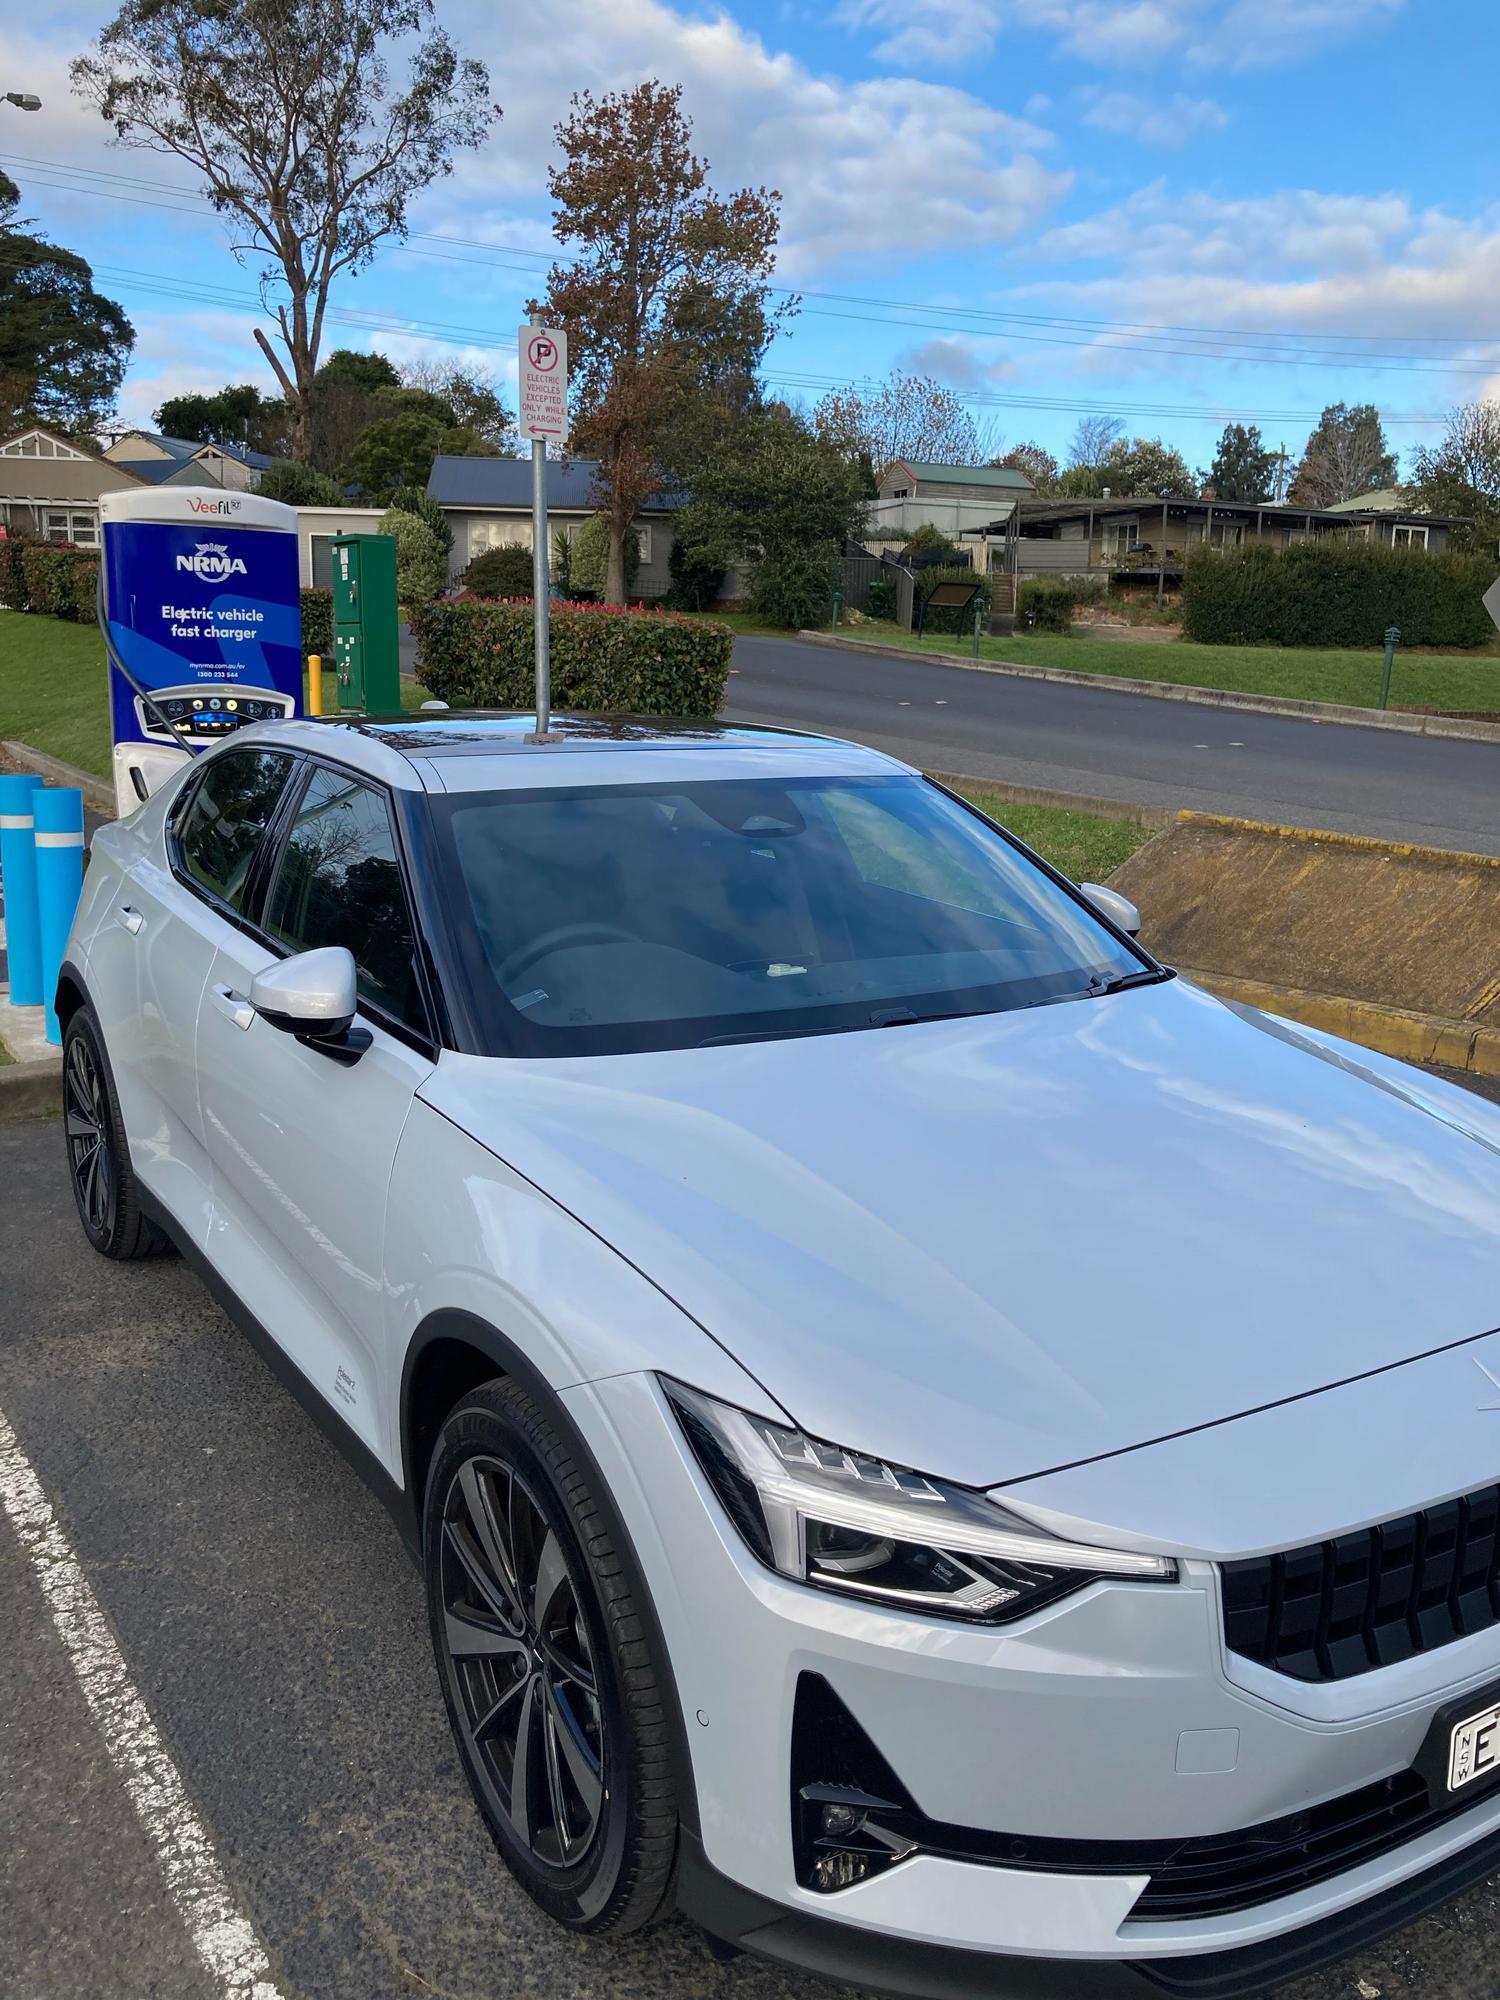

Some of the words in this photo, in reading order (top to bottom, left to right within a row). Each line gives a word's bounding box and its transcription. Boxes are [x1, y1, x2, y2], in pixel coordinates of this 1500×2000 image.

[537, 343, 551, 364] P
[527, 374, 560, 384] ELECTRIC
[527, 384, 560, 394] VEHICLES
[526, 393, 561, 404] EXCEPTED
[522, 403, 541, 412] ONLY
[545, 406, 566, 415] WHILE
[526, 413, 562, 425] CHARGING
[186, 496, 231, 515] Veefil
[176, 555, 248, 574] NRMA
[161, 605, 214, 620] Electric
[217, 608, 264, 621] vehicle
[171, 624, 200, 637] fast
[204, 625, 257, 642] charger
